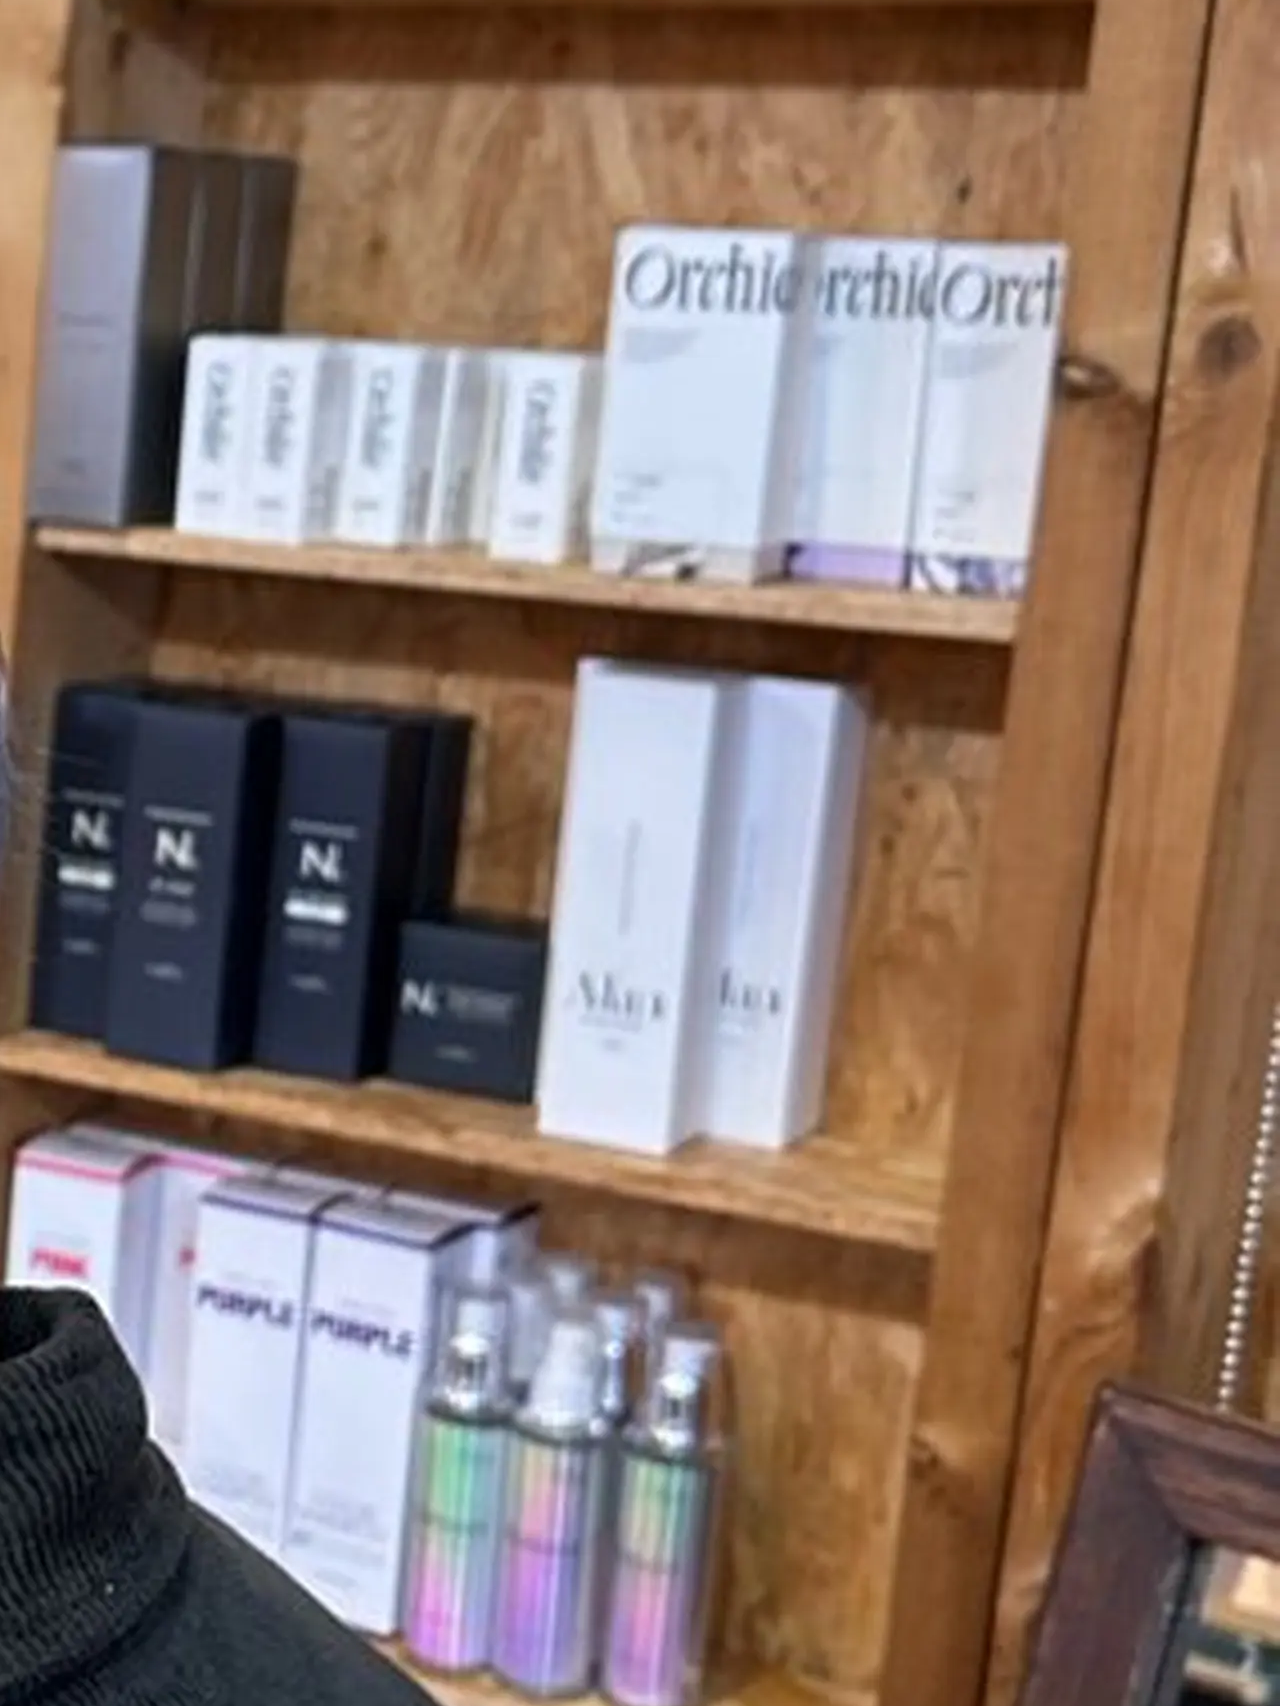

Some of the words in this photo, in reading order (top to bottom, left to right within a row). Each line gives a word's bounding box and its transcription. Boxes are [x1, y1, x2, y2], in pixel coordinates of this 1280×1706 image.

[818, 249, 938, 320] rchi
[197, 1284, 294, 1327] PURPLE
[311, 1315, 414, 1359] PURPLE
